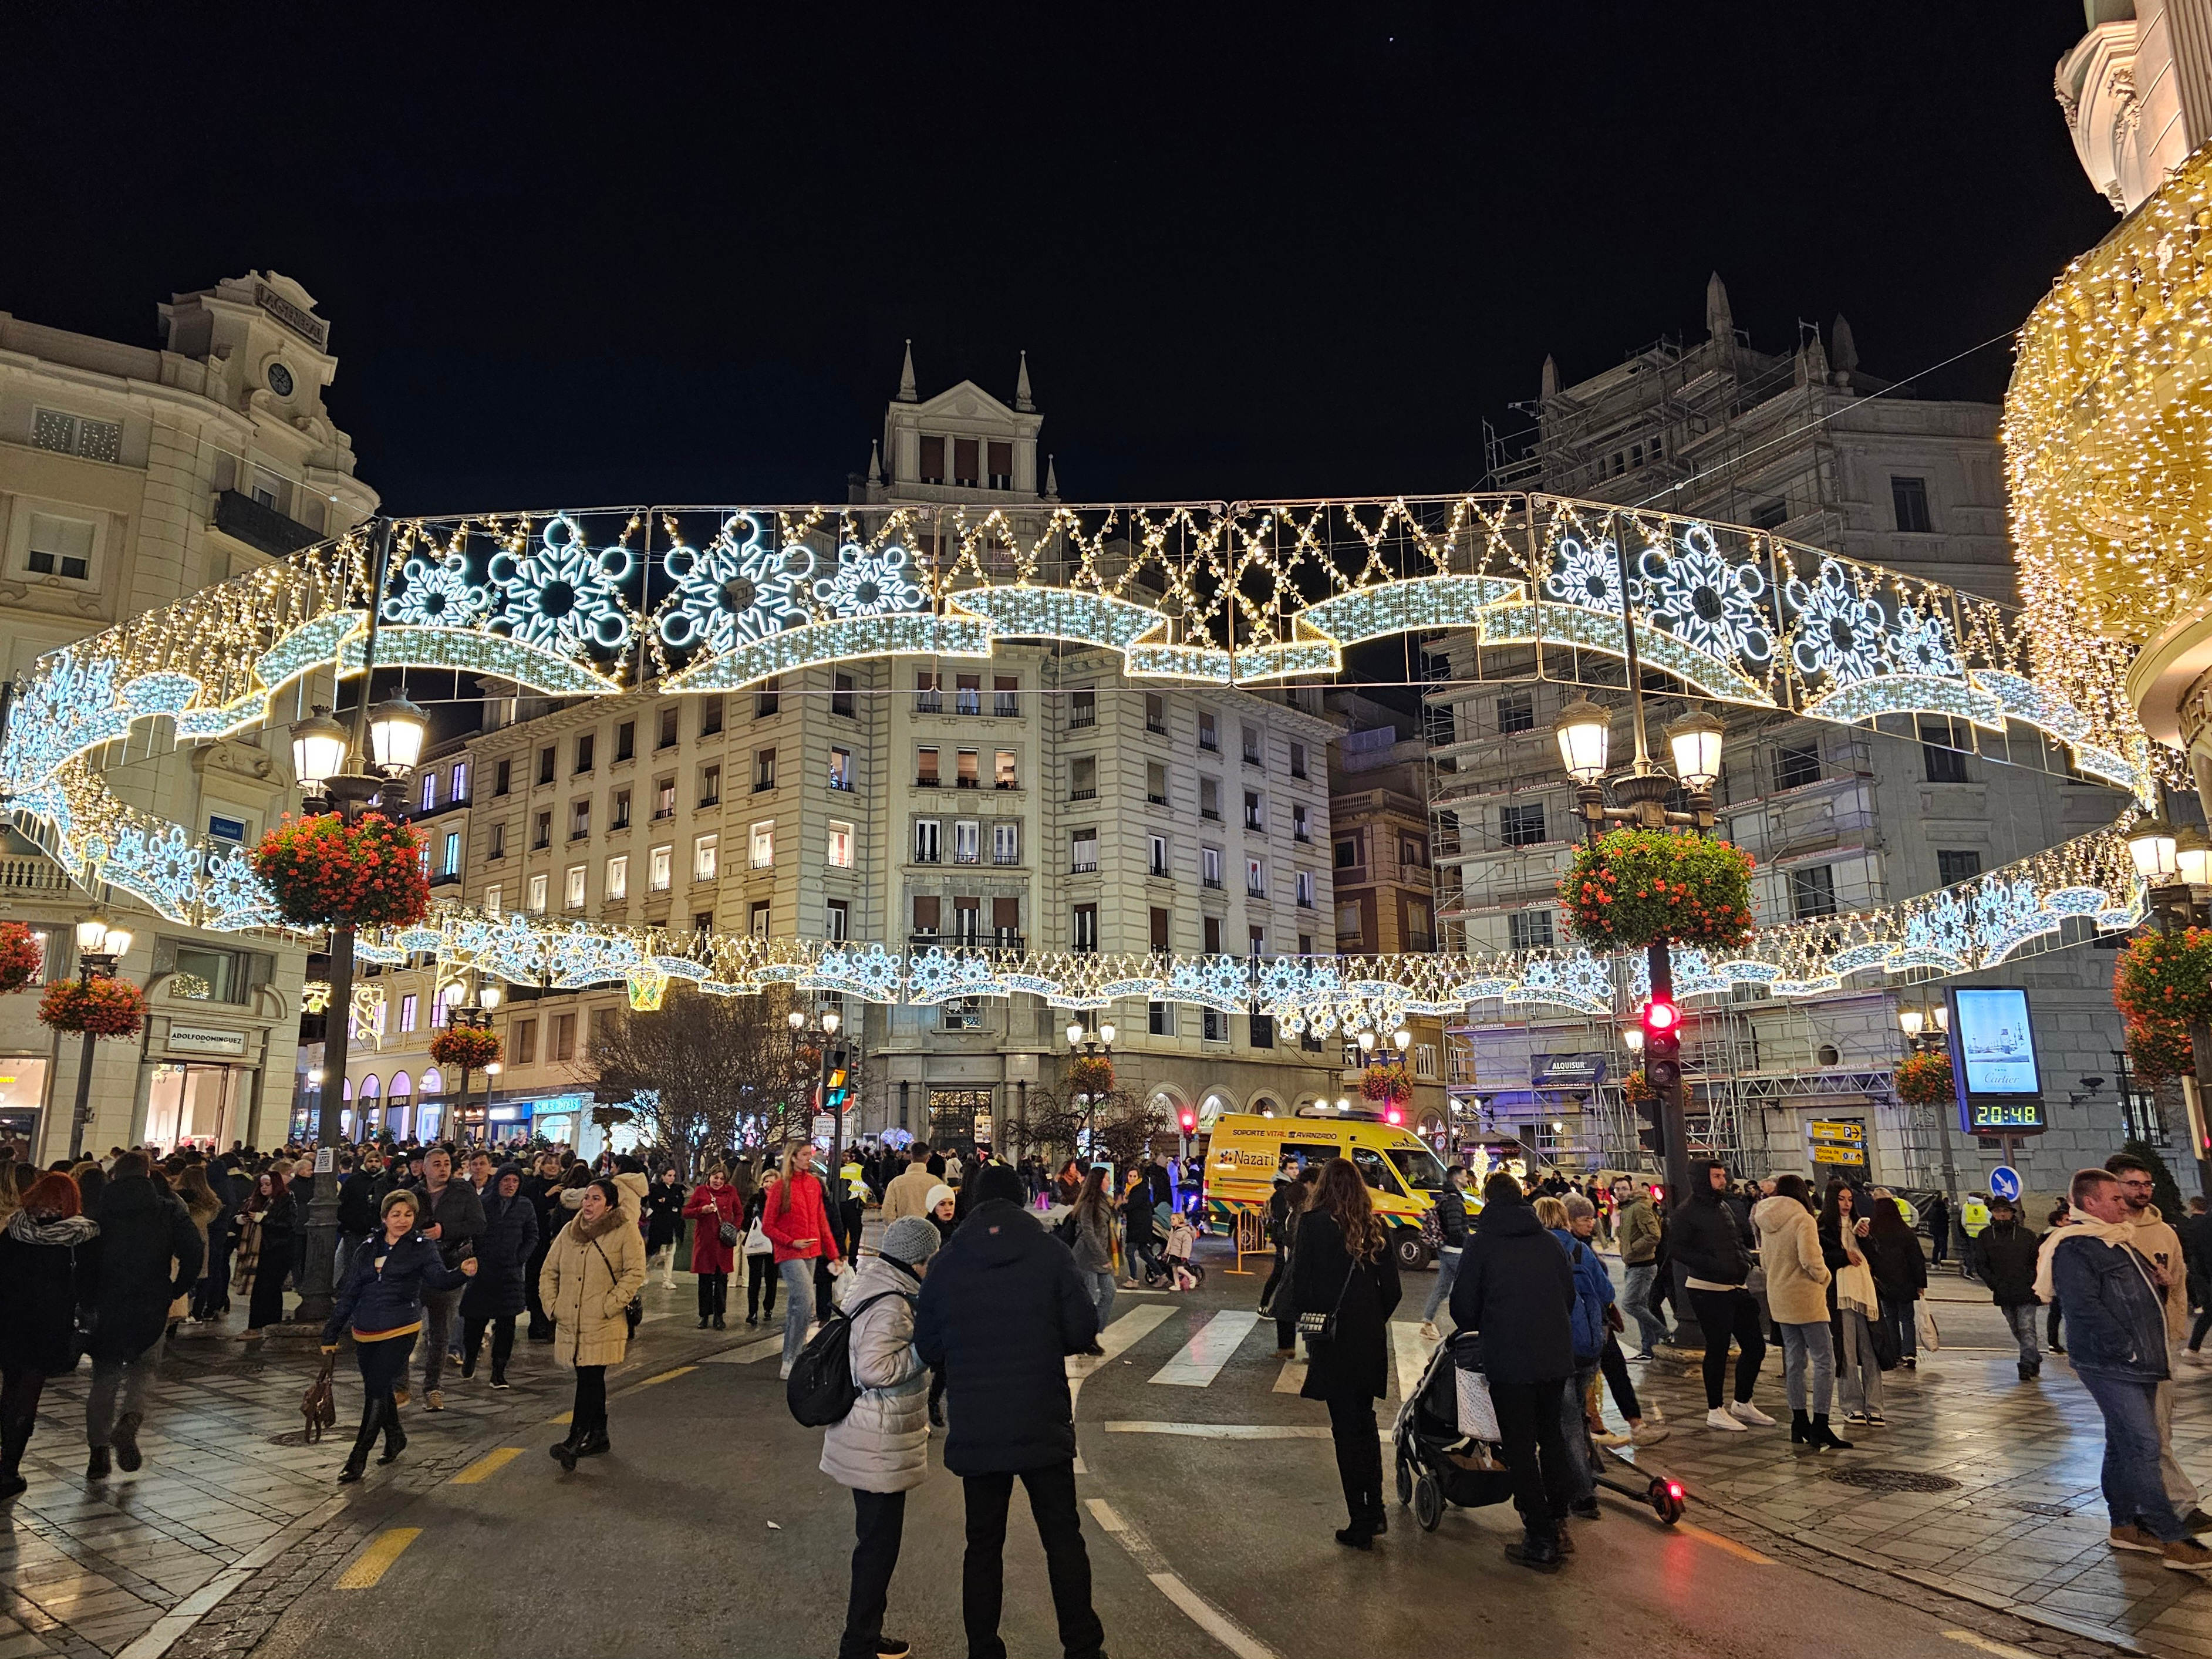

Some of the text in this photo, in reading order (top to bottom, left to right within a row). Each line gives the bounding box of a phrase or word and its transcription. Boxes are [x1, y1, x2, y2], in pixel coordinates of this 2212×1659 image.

[1675, 369, 1714, 394] ALQUISUR
[1746, 390, 1788, 415] ALQUISUR
[1588, 471, 1628, 491] ALQUISUR
[1514, 724, 1552, 736] ALQUISU
[1444, 738, 1485, 749] ALQUISUR
[1519, 781, 1562, 791] ALQUISUR
[1790, 777, 1836, 793] ALQUISUR
[1450, 792, 1491, 802] ALQUISUR
[1718, 798, 1759, 812] ALQUISUR
[1523, 839, 1566, 849] ALQUISUR
[1459, 905, 1501, 914] ALQUISUR
[1552, 1061, 1585, 1070] ALQUISUR
[1821, 1063, 1870, 1072] ALQUISUR
[1745, 1068, 1790, 1077] ALQUISUR
[1984, 1072, 2020, 1084] Cartier
[1977, 1106, 2035, 1123] 20:48
[1296, 1131, 1337, 1139] AVANZADO
[1234, 1151, 1274, 1166] Nazari
